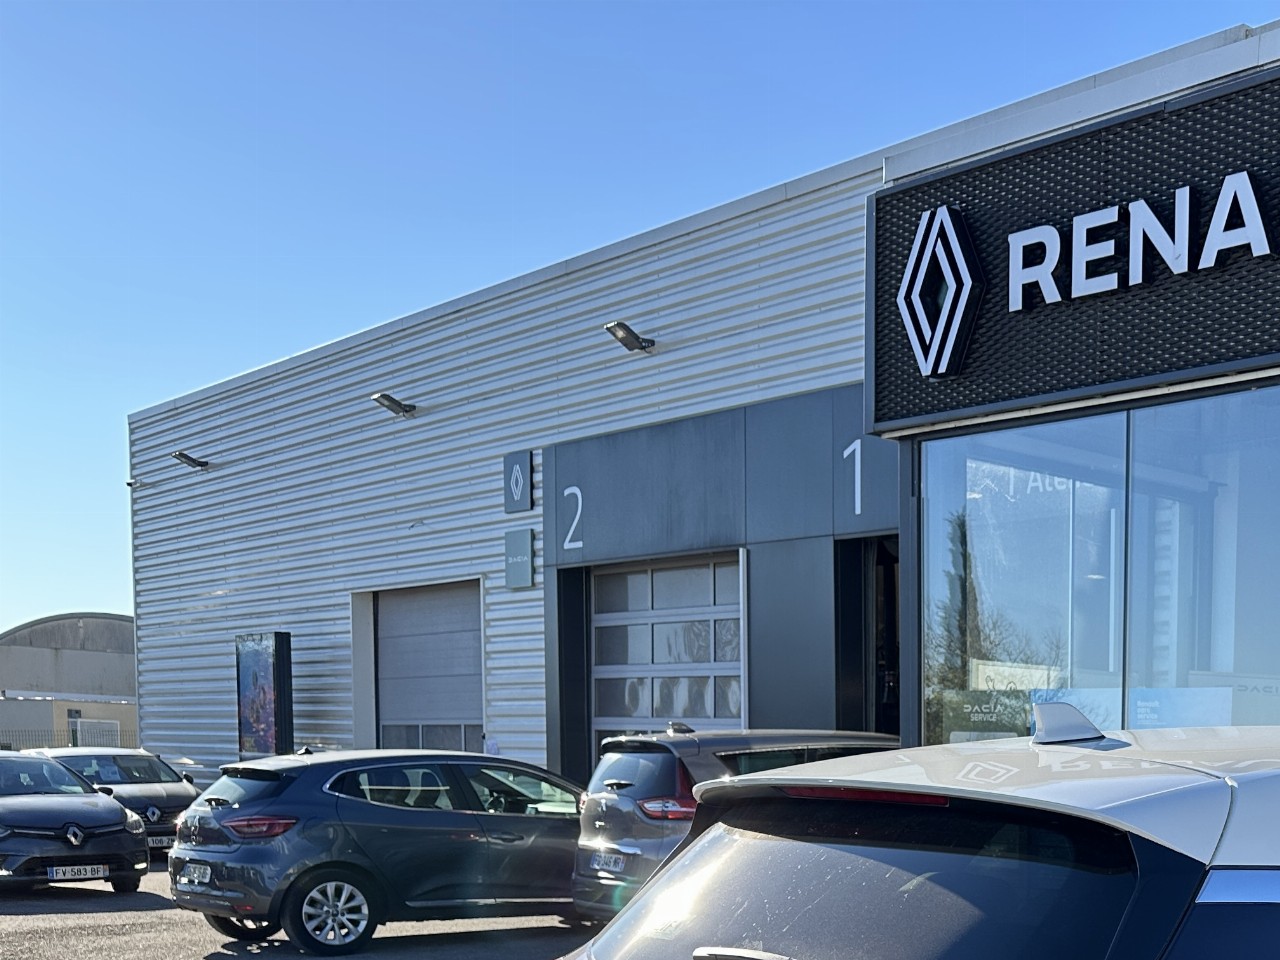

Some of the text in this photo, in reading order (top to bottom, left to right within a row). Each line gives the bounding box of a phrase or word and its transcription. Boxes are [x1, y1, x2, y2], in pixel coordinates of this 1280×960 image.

[843, 438, 861, 515] 1
[563, 485, 584, 550] 2
[963, 704, 1003, 713] DACIA
[970, 713, 997, 721] SERVICE
